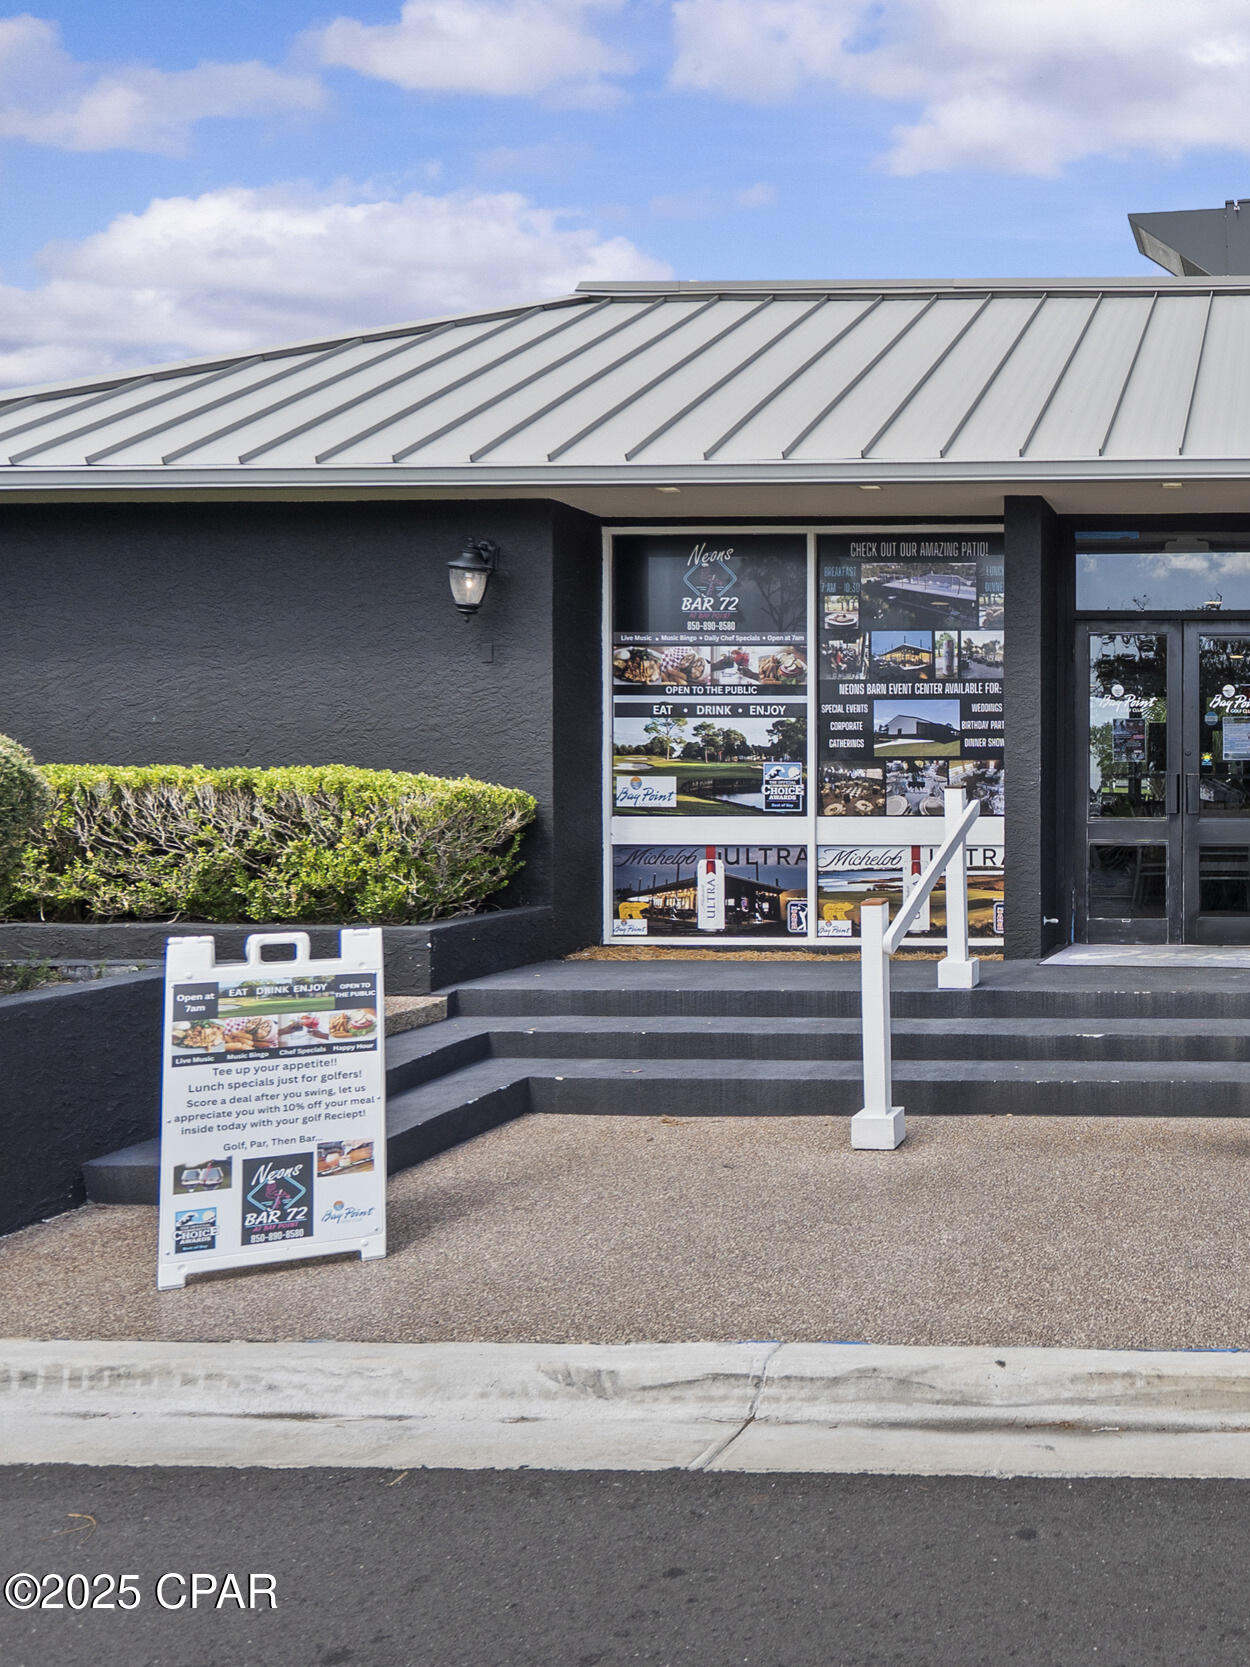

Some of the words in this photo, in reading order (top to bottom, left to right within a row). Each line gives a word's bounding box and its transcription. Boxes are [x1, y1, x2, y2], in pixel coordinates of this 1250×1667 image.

[687, 543, 734, 566] Neons
[850, 542, 876, 556] CHECK
[881, 542, 896, 556] OUT
[901, 542, 917, 556] OUR
[920, 542, 958, 556] AMAZING
[961, 542, 988, 556] PATIO!
[682, 598, 713, 610] BAR
[720, 598, 738, 610] 72
[666, 686, 690, 694] OPEN
[692, 686, 704, 694] TO
[706, 686, 721, 694] THE
[725, 686, 757, 694] PUBLIC
[839, 684, 864, 695] NEONS
[867, 684, 886, 695] BARN
[889, 684, 912, 694] EVENT
[915, 684, 942, 694] CENTER
[945, 683, 982, 694] AVAILABLE
[986, 683, 1002, 694] FOR:
[821, 704, 844, 713] SPECIAL
[846, 704, 868, 713] EVENTS
[972, 704, 1002, 712] WEDDINGS
[1209, 694, 1233, 713] Bay
[653, 706, 672, 714] EAT
[697, 706, 731, 714] DRINK
[750, 706, 786, 714] ENJOY
[830, 722, 863, 730] CORPORATE
[962, 721, 988, 729] BIRTHDAY
[829, 739, 864, 748] GATHERINGS
[965, 738, 986, 747] DINNER
[762, 784, 804, 795] CHOICE
[616, 787, 640, 806] Bay
[643, 788, 674, 802] Point
[615, 847, 700, 867] Michelob
[725, 848, 807, 865] ULTRA
[818, 849, 905, 868] Michelob
[707, 879, 715, 919] ULTRA
[229, 988, 248, 997] EAT
[256, 986, 289, 996] DRINK
[293, 984, 327, 993] ENJOY
[177, 994, 203, 1003] Open
[185, 1004, 206, 1013] 7am
[298, 1046, 326, 1056] Specials
[333, 1044, 355, 1053] Happy
[356, 1042, 374, 1050] Hour
[191, 1055, 214, 1063] Music
[227, 1053, 248, 1061] Music
[212, 1067, 232, 1076] Tee
[236, 1066, 250, 1076] up
[253, 1064, 280, 1075] your
[283, 1058, 338, 1071] appetite!!
[188, 1080, 224, 1093] Lunch
[228, 1077, 274, 1091] specials
[276, 1076, 298, 1087] just
[302, 1073, 318, 1083] for
[321, 1070, 362, 1083] golfers!
[187, 1098, 217, 1108] Score
[229, 1094, 252, 1104] deal
[254, 1091, 279, 1102] after
[283, 1091, 302, 1102] you
[304, 1088, 336, 1097] swing,
[339, 1086, 352, 1094] let
[354, 1084, 365, 1092] us
[174, 1110, 232, 1124] appreciate
[235, 1107, 254, 1117] you
[258, 1104, 280, 1114] with
[283, 1102, 304, 1111] 10%
[307, 1100, 322, 1110] off
[325, 1099, 348, 1110] your
[350, 1096, 375, 1105] meal
[181, 1124, 214, 1135] inside
[217, 1120, 247, 1133] today
[250, 1118, 272, 1128] with
[275, 1116, 298, 1128] your
[302, 1113, 321, 1125] golf
[324, 1109, 366, 1121] Reciept!
[223, 1142, 247, 1152] Golf,
[250, 1140, 269, 1149] Par,
[272, 1137, 296, 1146] Then
[251, 1162, 303, 1186] Neons
[244, 1210, 279, 1226] BAR
[286, 1207, 308, 1220] 72
[173, 1225, 220, 1242] CHOICE
